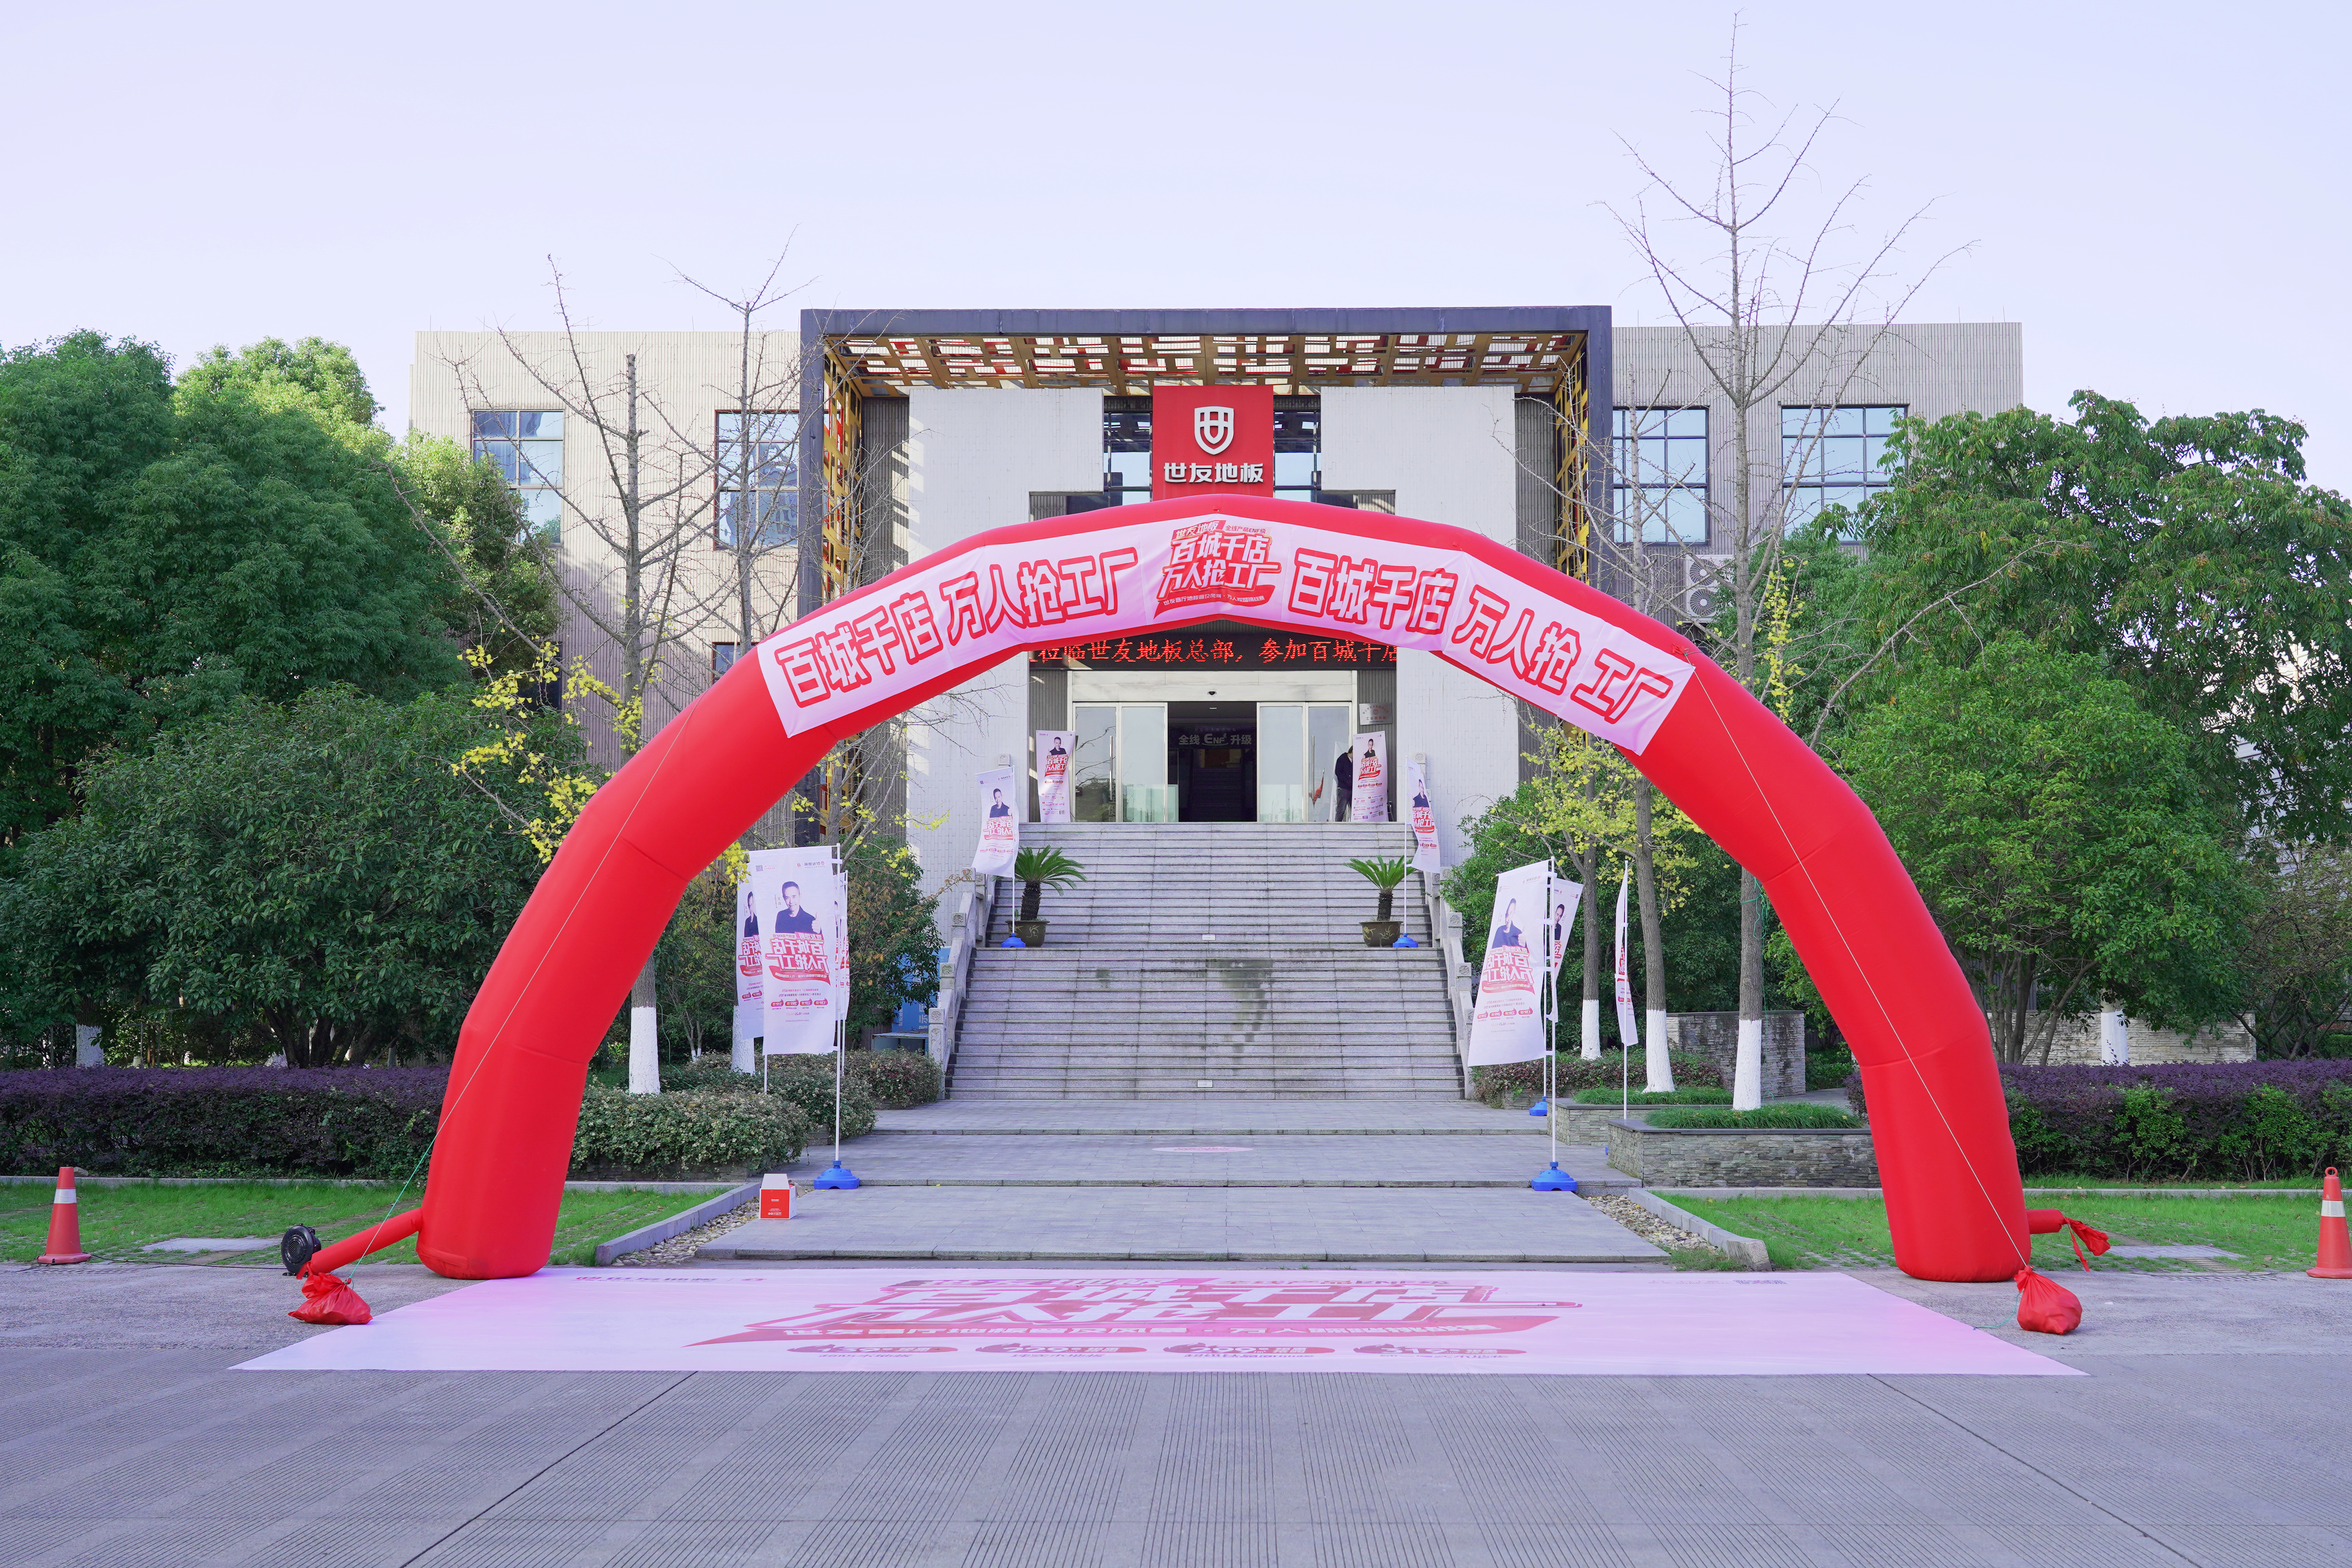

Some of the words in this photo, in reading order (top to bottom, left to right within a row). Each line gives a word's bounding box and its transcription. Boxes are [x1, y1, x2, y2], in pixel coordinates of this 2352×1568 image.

[1164, 462, 1264, 483] 世友地板
[1176, 521, 1220, 537] 世友地板
[1225, 525, 1266, 534] 全线产品ENF级
[1171, 532, 1270, 564] 百城千店
[1157, 559, 1281, 600] 万人抢工厂
[774, 590, 943, 708] 百城千店
[939, 547, 1138, 646] 万人抢工厂
[1288, 548, 1458, 635] 百城千店
[1452, 584, 1673, 724] 万人抢工厂
[1178, 734, 1200, 746] 全线
[1204, 733, 1227, 746] ENF
[1230, 734, 1252, 746] 升级
[878, 1285, 1486, 1303] 百城千店
[751, 1301, 1572, 1328] 万人抢工厂
